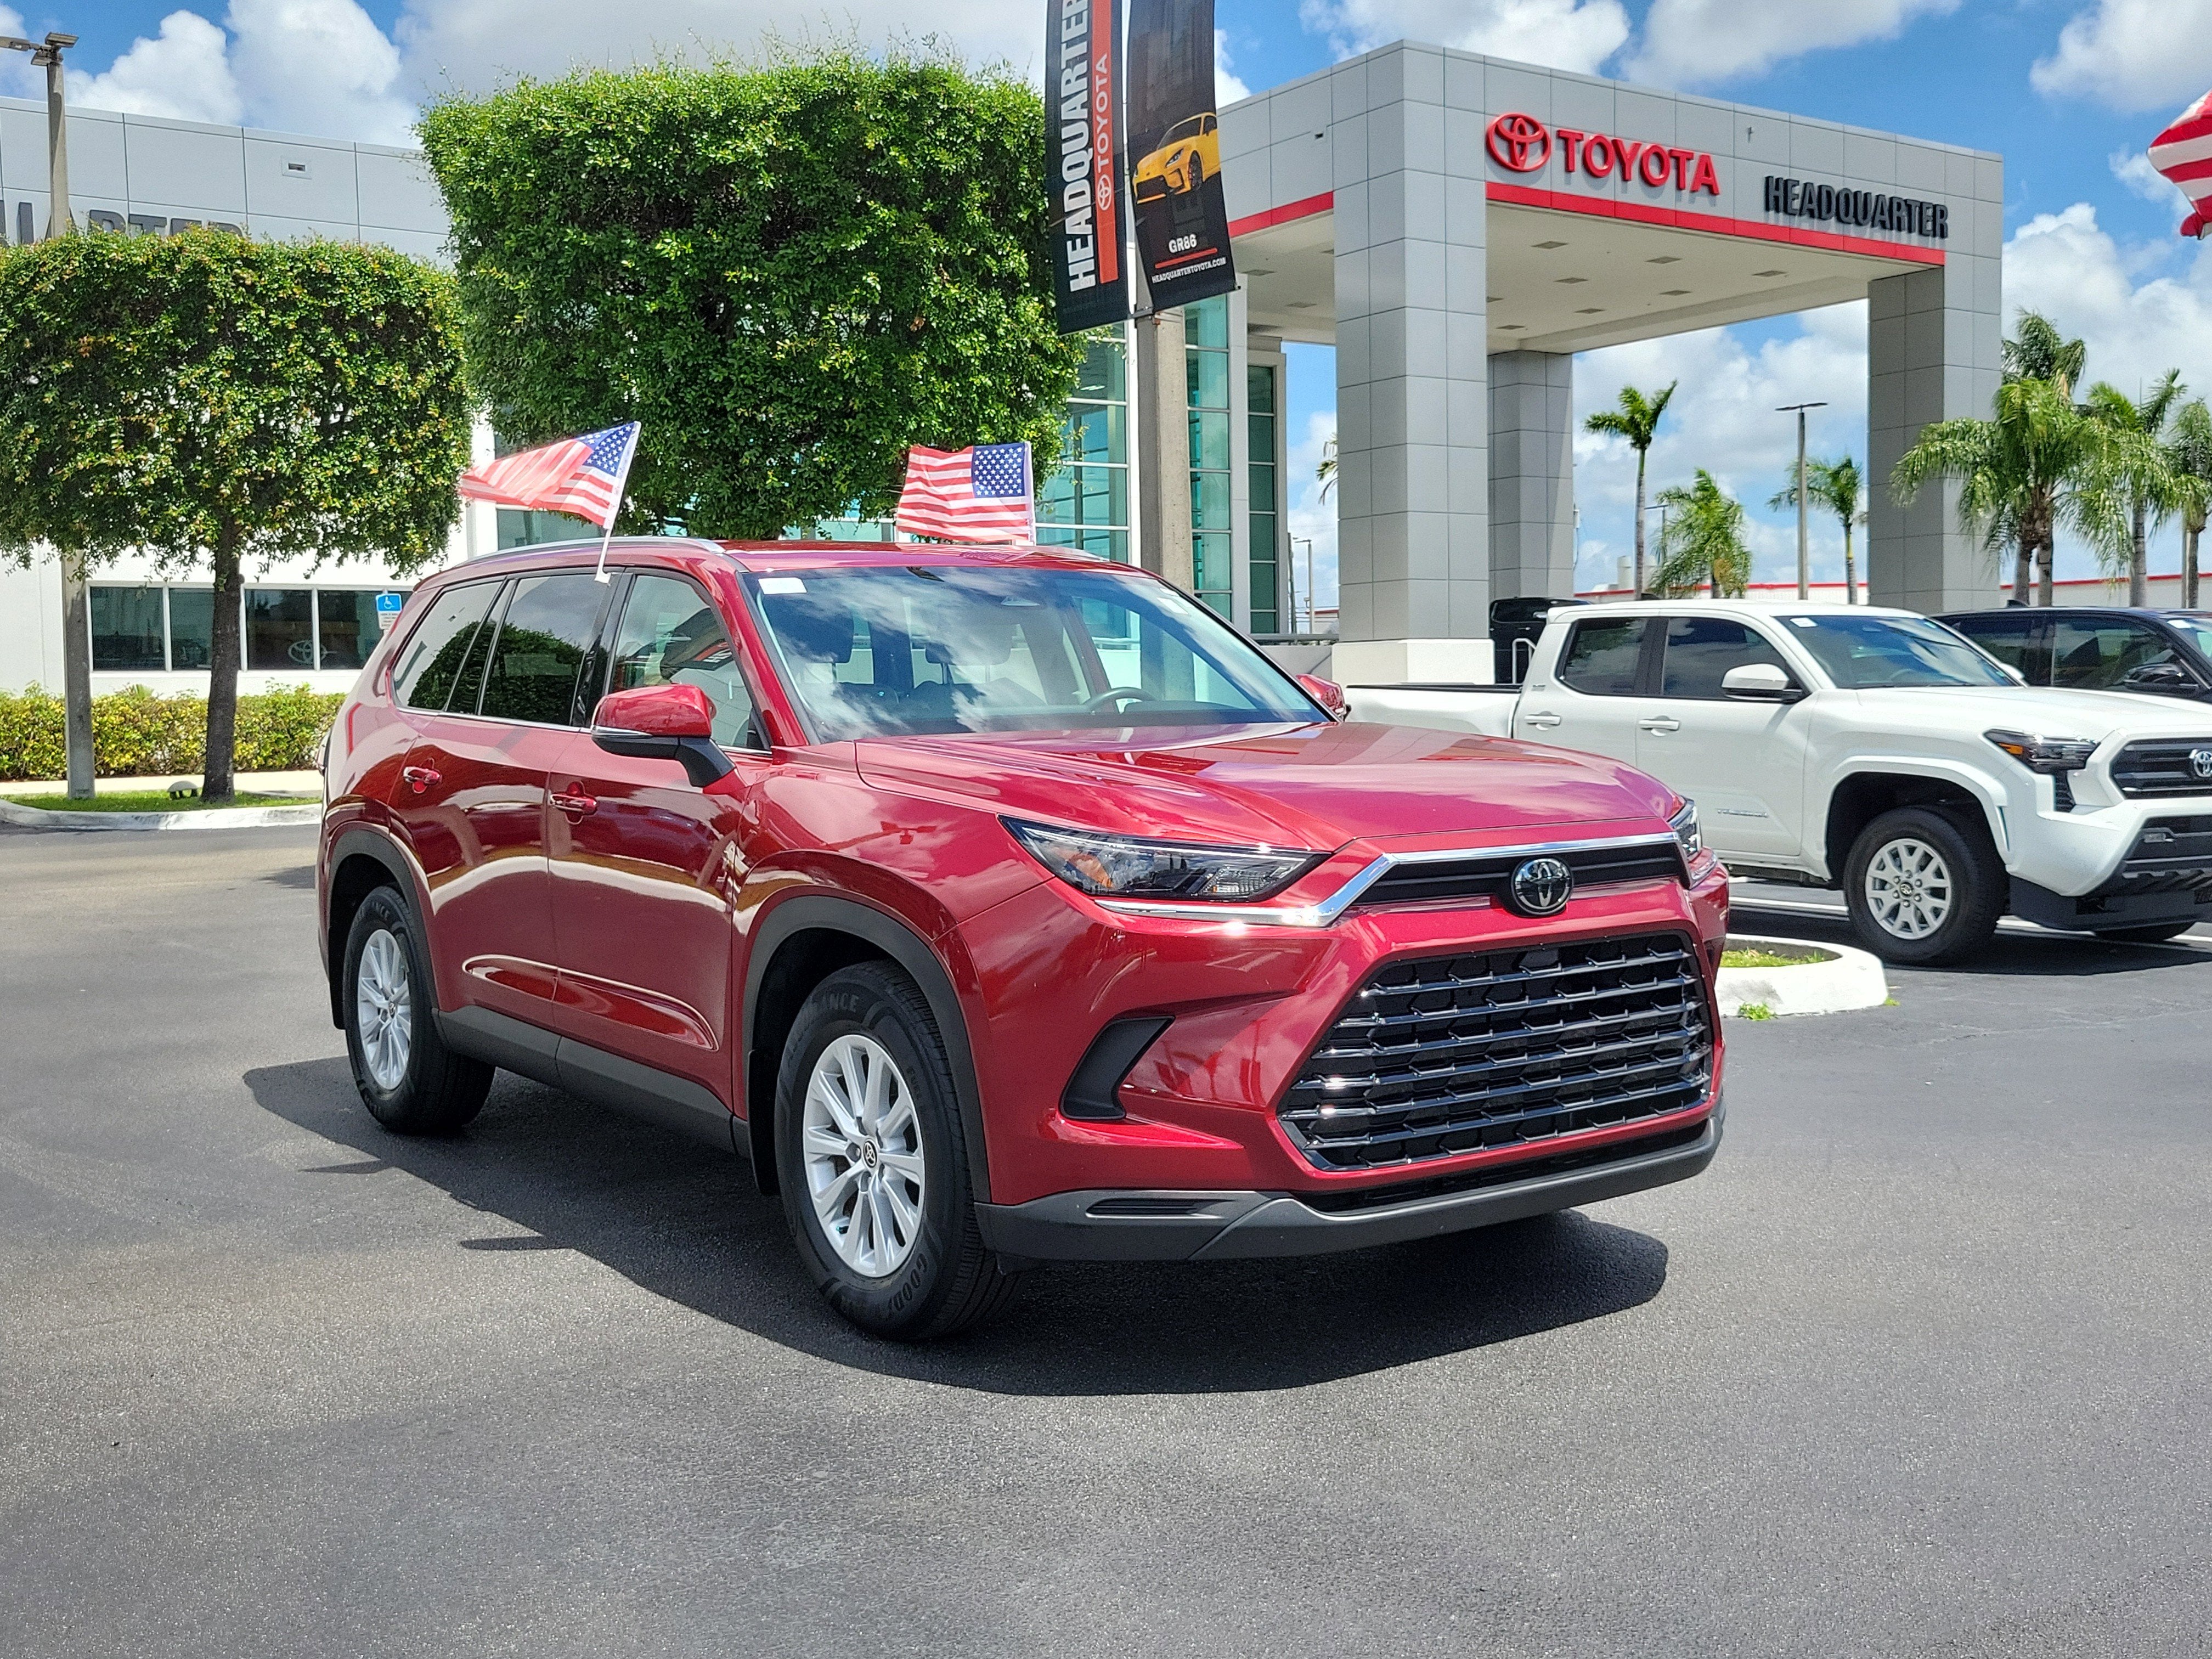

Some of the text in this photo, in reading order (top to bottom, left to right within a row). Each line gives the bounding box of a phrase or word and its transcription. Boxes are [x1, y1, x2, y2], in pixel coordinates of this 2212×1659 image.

[1096, 53, 1109, 173] TOYOTA
[1556, 129, 1720, 195] TOYOTA
[1764, 176, 1948, 238] HEADQUARTER
[1152, 257, 1227, 284] HEADQUARTERTOYOTA.COM
[1169, 234, 1197, 253] GR86
